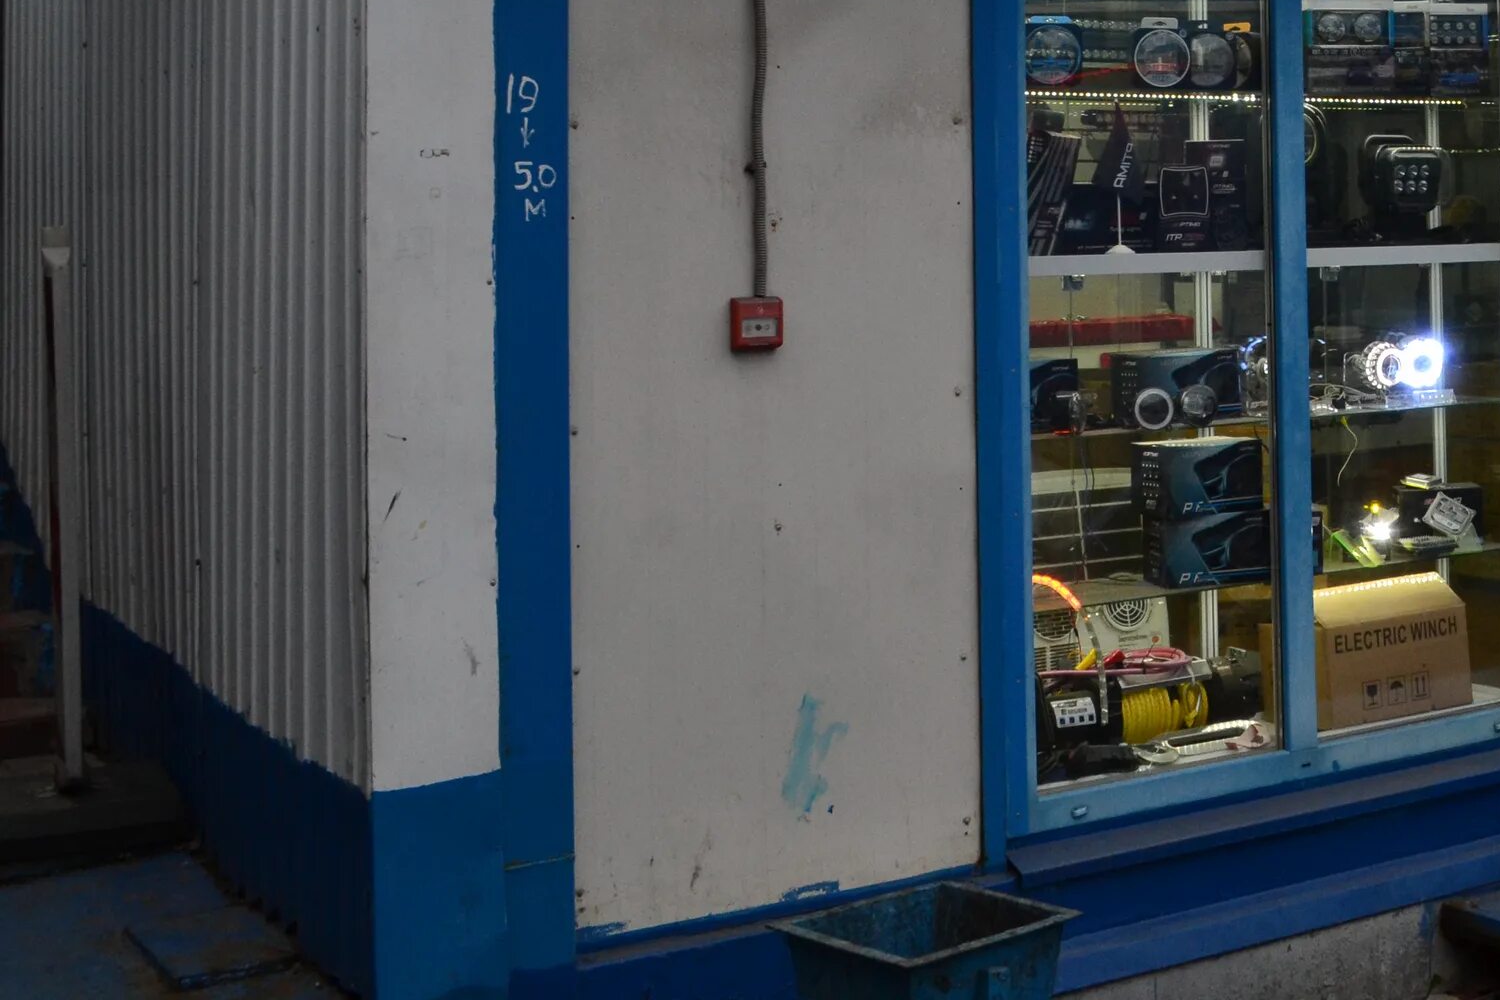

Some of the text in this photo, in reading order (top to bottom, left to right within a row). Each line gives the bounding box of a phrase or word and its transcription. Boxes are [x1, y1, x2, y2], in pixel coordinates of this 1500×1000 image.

[506, 73, 540, 114] 19
[1334, 615, 1459, 654] ELECTRIC WINCH
